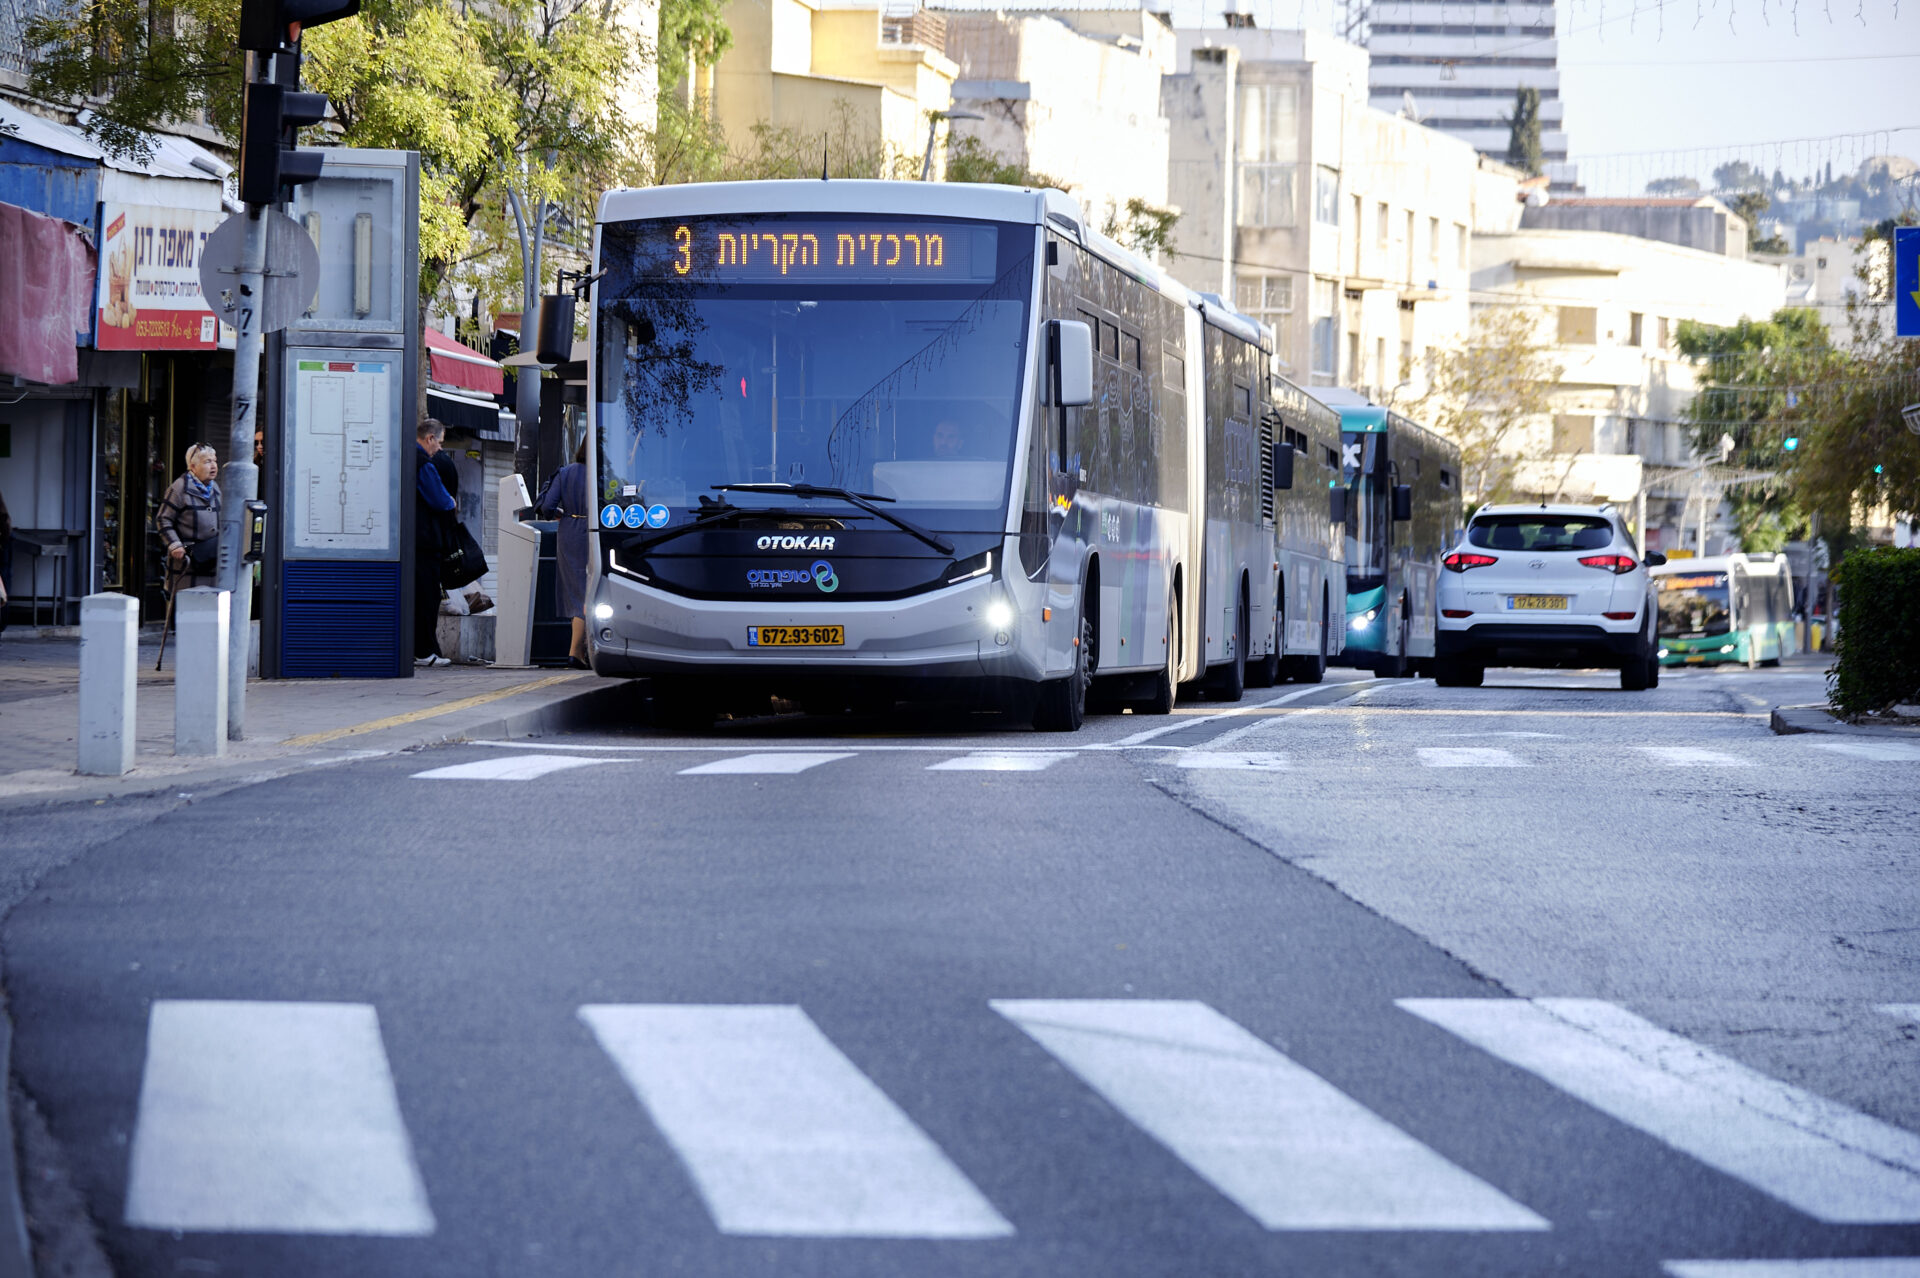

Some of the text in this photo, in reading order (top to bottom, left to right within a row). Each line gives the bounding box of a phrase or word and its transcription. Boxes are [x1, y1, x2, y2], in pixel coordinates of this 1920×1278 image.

[133, 226, 154, 277] דגן
[158, 228, 194, 268] מאפה
[674, 225, 692, 275] 3
[718, 233, 943, 275] מרכזית הקריות
[756, 535, 836, 551] OTOKAR
[747, 569, 811, 583] סופרבוס
